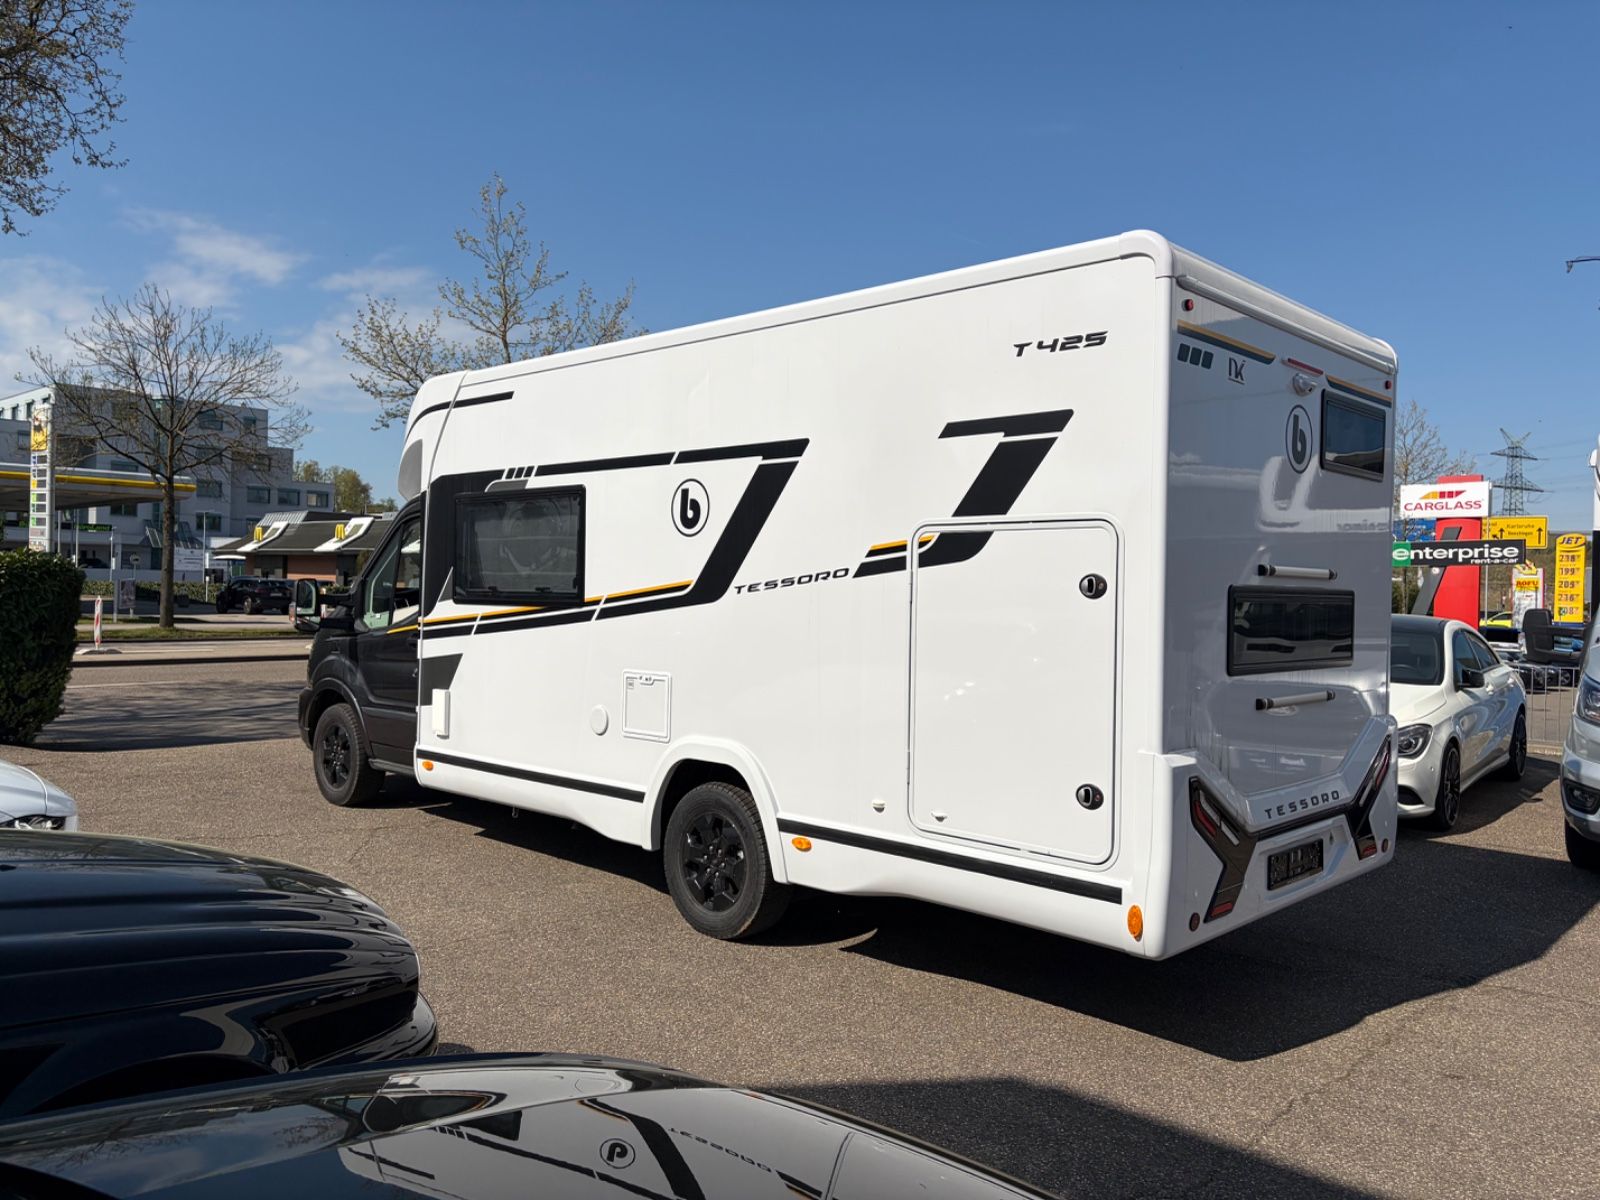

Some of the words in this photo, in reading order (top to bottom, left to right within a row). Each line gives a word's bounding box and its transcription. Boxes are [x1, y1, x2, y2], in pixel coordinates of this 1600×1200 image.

[1013, 341, 1033, 357] T
[1036, 330, 1108, 352] 425
[1403, 500, 1482, 512] CARGLASS
[1559, 536, 1582, 545] JET
[1392, 544, 1519, 562] enterprise
[734, 568, 850, 595] TESSORO
[1264, 790, 1341, 819] TESSORO
